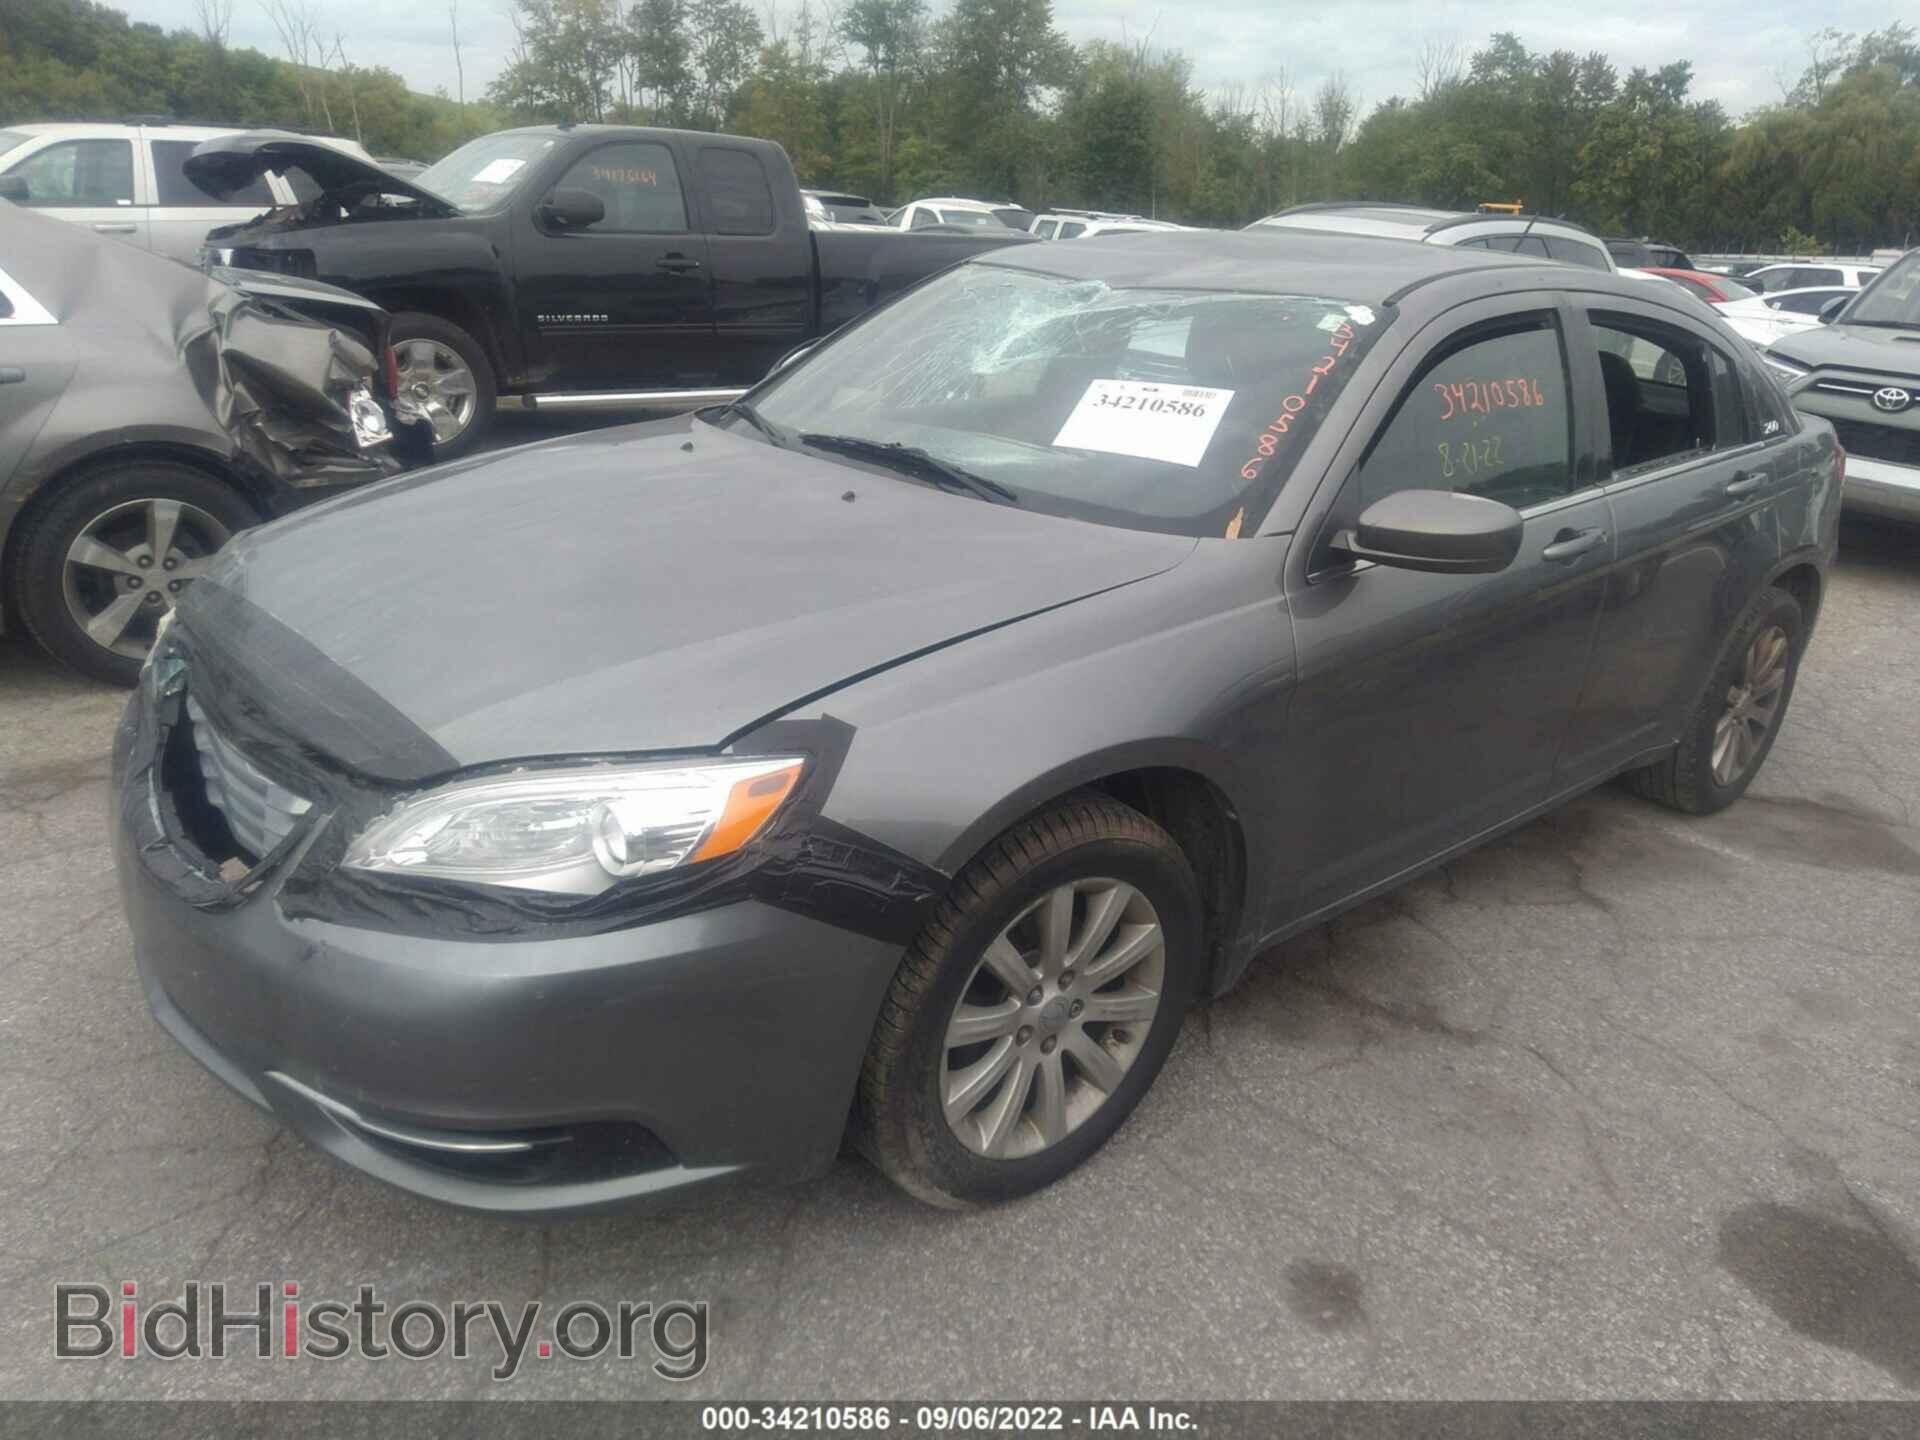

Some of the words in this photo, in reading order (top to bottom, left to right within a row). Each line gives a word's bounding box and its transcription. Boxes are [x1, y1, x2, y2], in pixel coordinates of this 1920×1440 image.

[537, 313, 608, 322] SILVERADO
[1093, 393, 1206, 419] 34210586
[1433, 379, 1545, 421] 34210586
